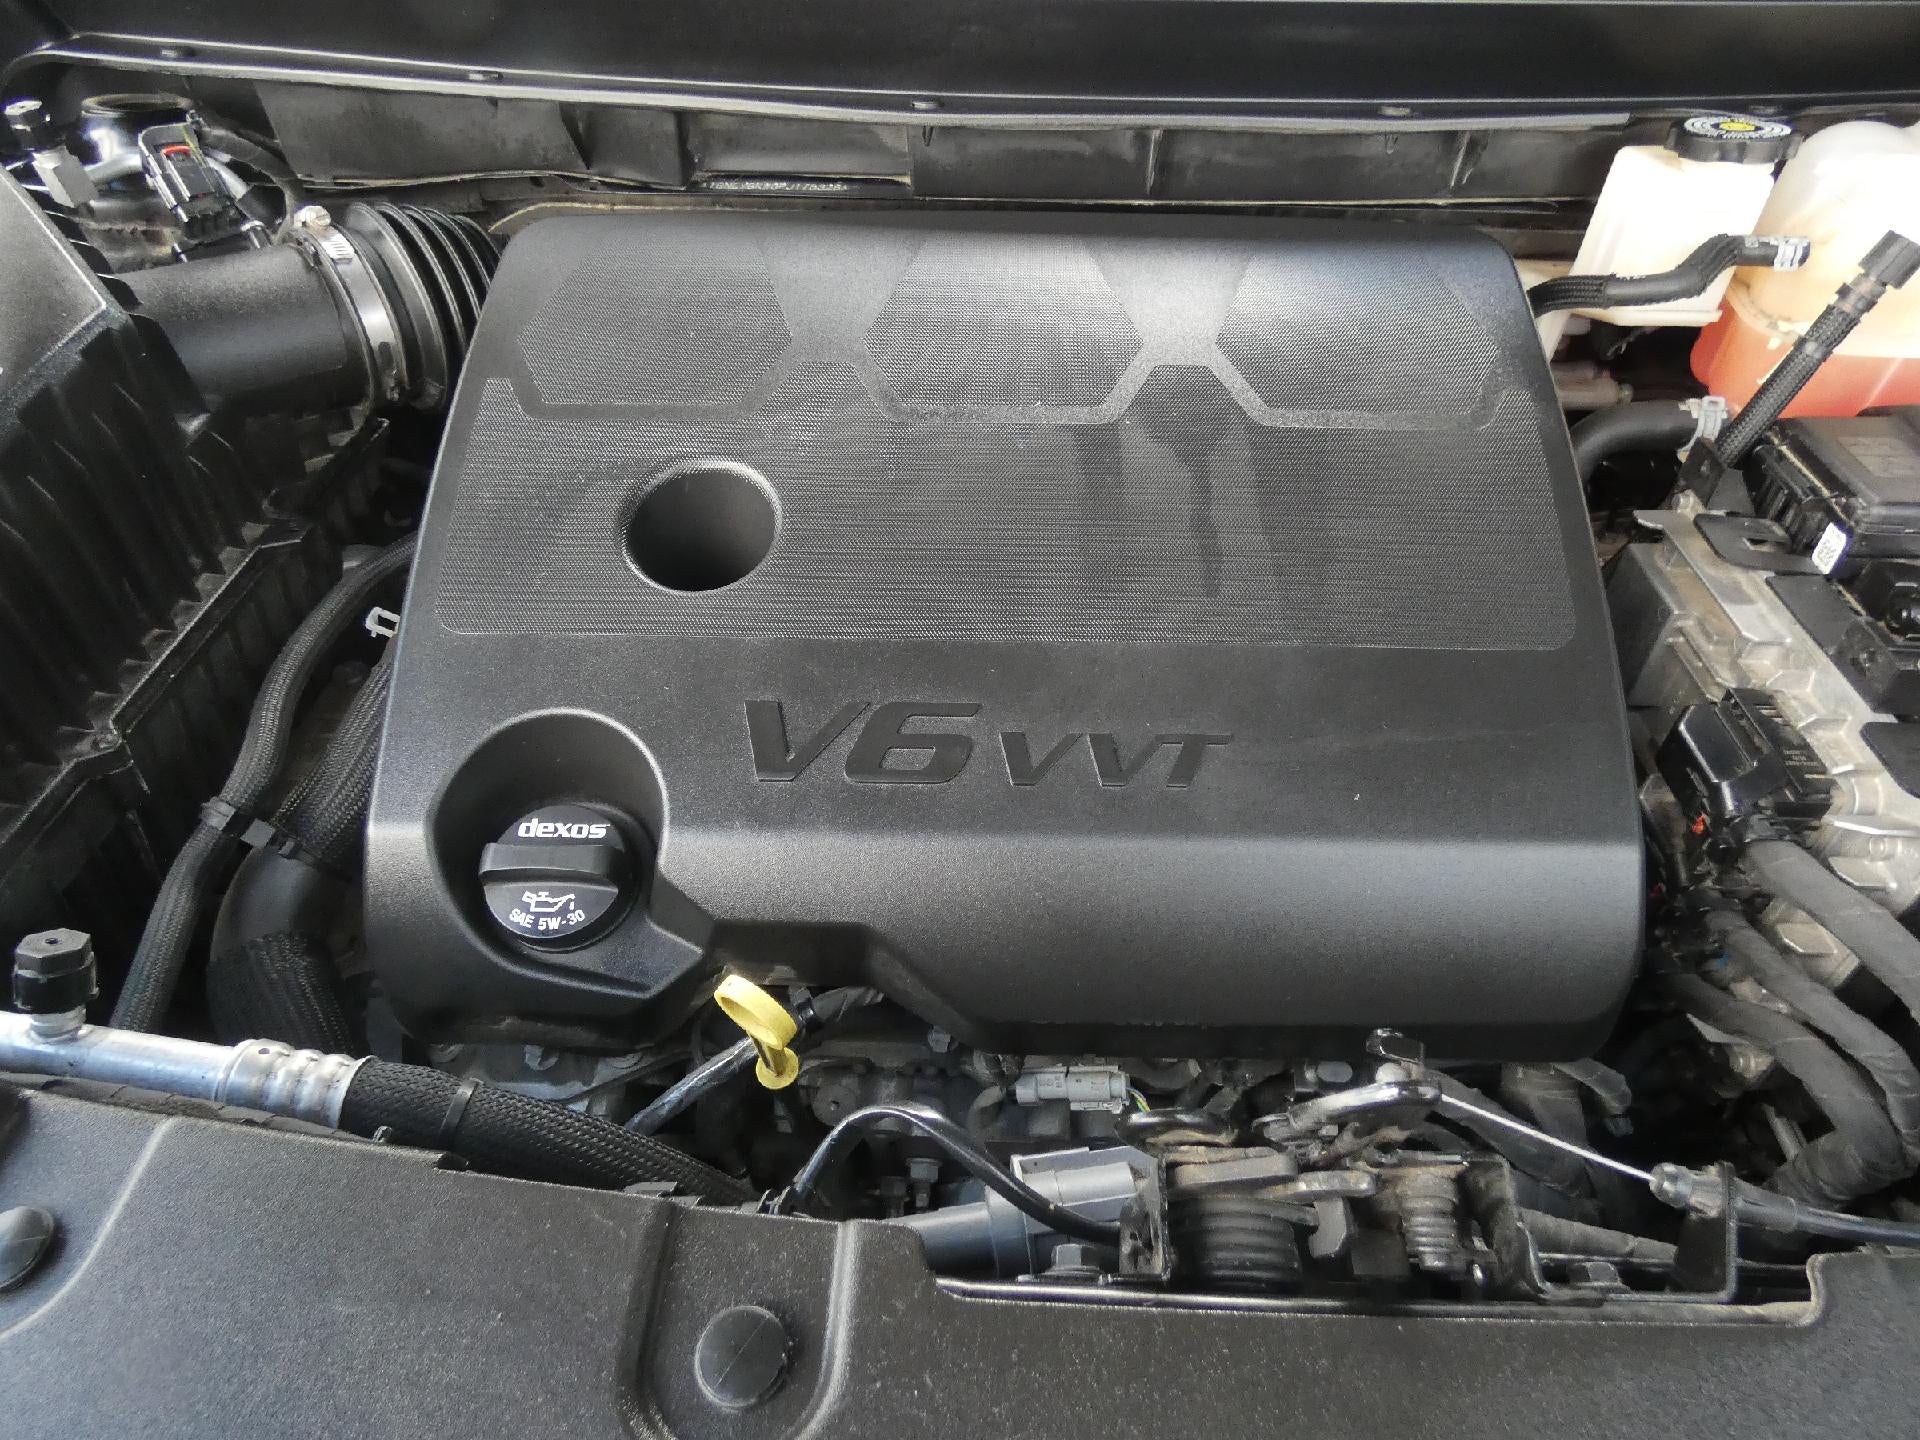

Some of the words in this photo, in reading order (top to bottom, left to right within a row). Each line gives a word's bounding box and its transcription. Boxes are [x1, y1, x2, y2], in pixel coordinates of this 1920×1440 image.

[744, 699, 982, 784] V6
[1000, 731, 1234, 788] VVT
[517, 817, 611, 839] dexos
[509, 908, 535, 929] SAE
[537, 909, 586, 931] 5W-30
